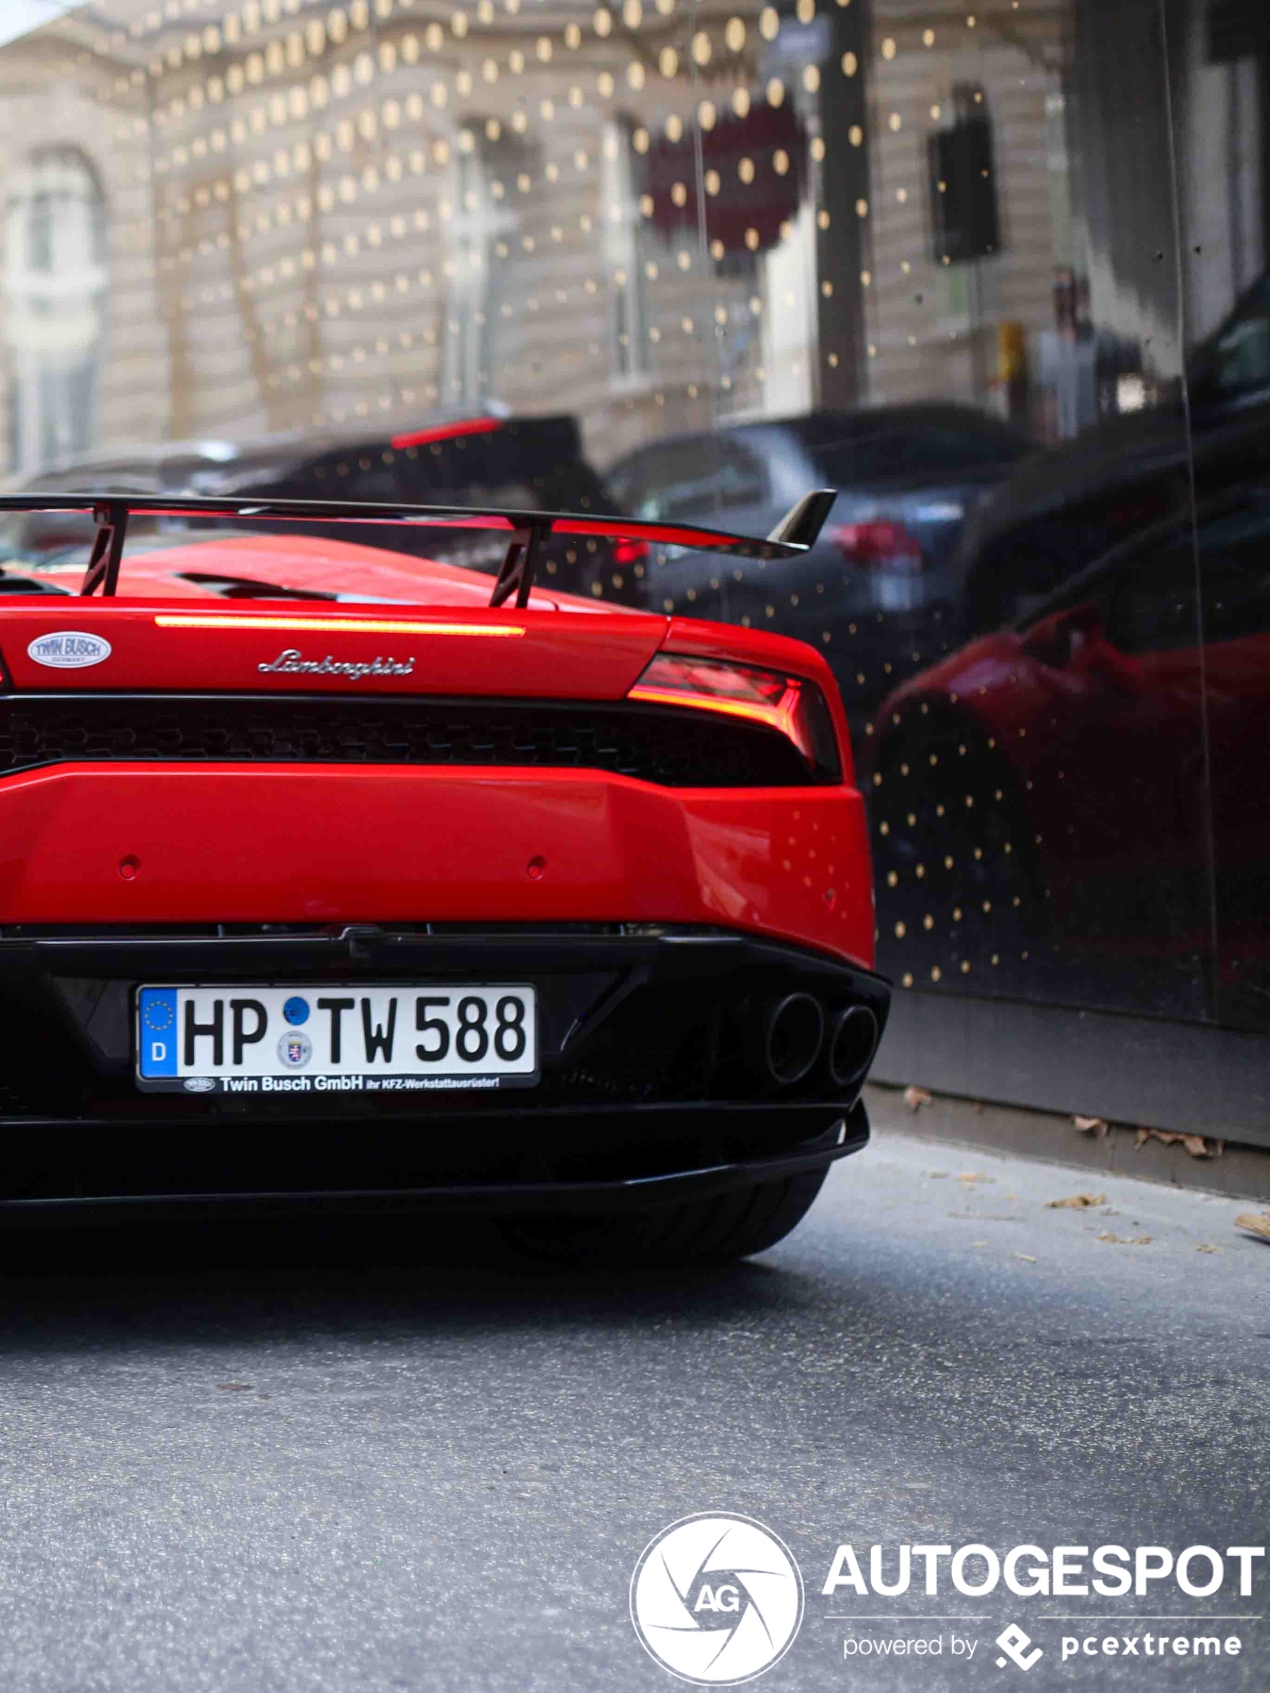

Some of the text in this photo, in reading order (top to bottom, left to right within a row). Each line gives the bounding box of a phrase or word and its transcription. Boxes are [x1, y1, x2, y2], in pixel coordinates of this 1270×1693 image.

[36, 637, 101, 656] TWIN BUSCH
[257, 648, 416, 680] Lamborghini
[183, 998, 268, 1066] HP
[317, 997, 398, 1064] TW
[415, 996, 526, 1063] 588
[152, 1042, 166, 1061] D
[220, 1076, 258, 1091] Twin
[262, 1076, 311, 1091] Busch
[315, 1075, 363, 1091] GmbH
